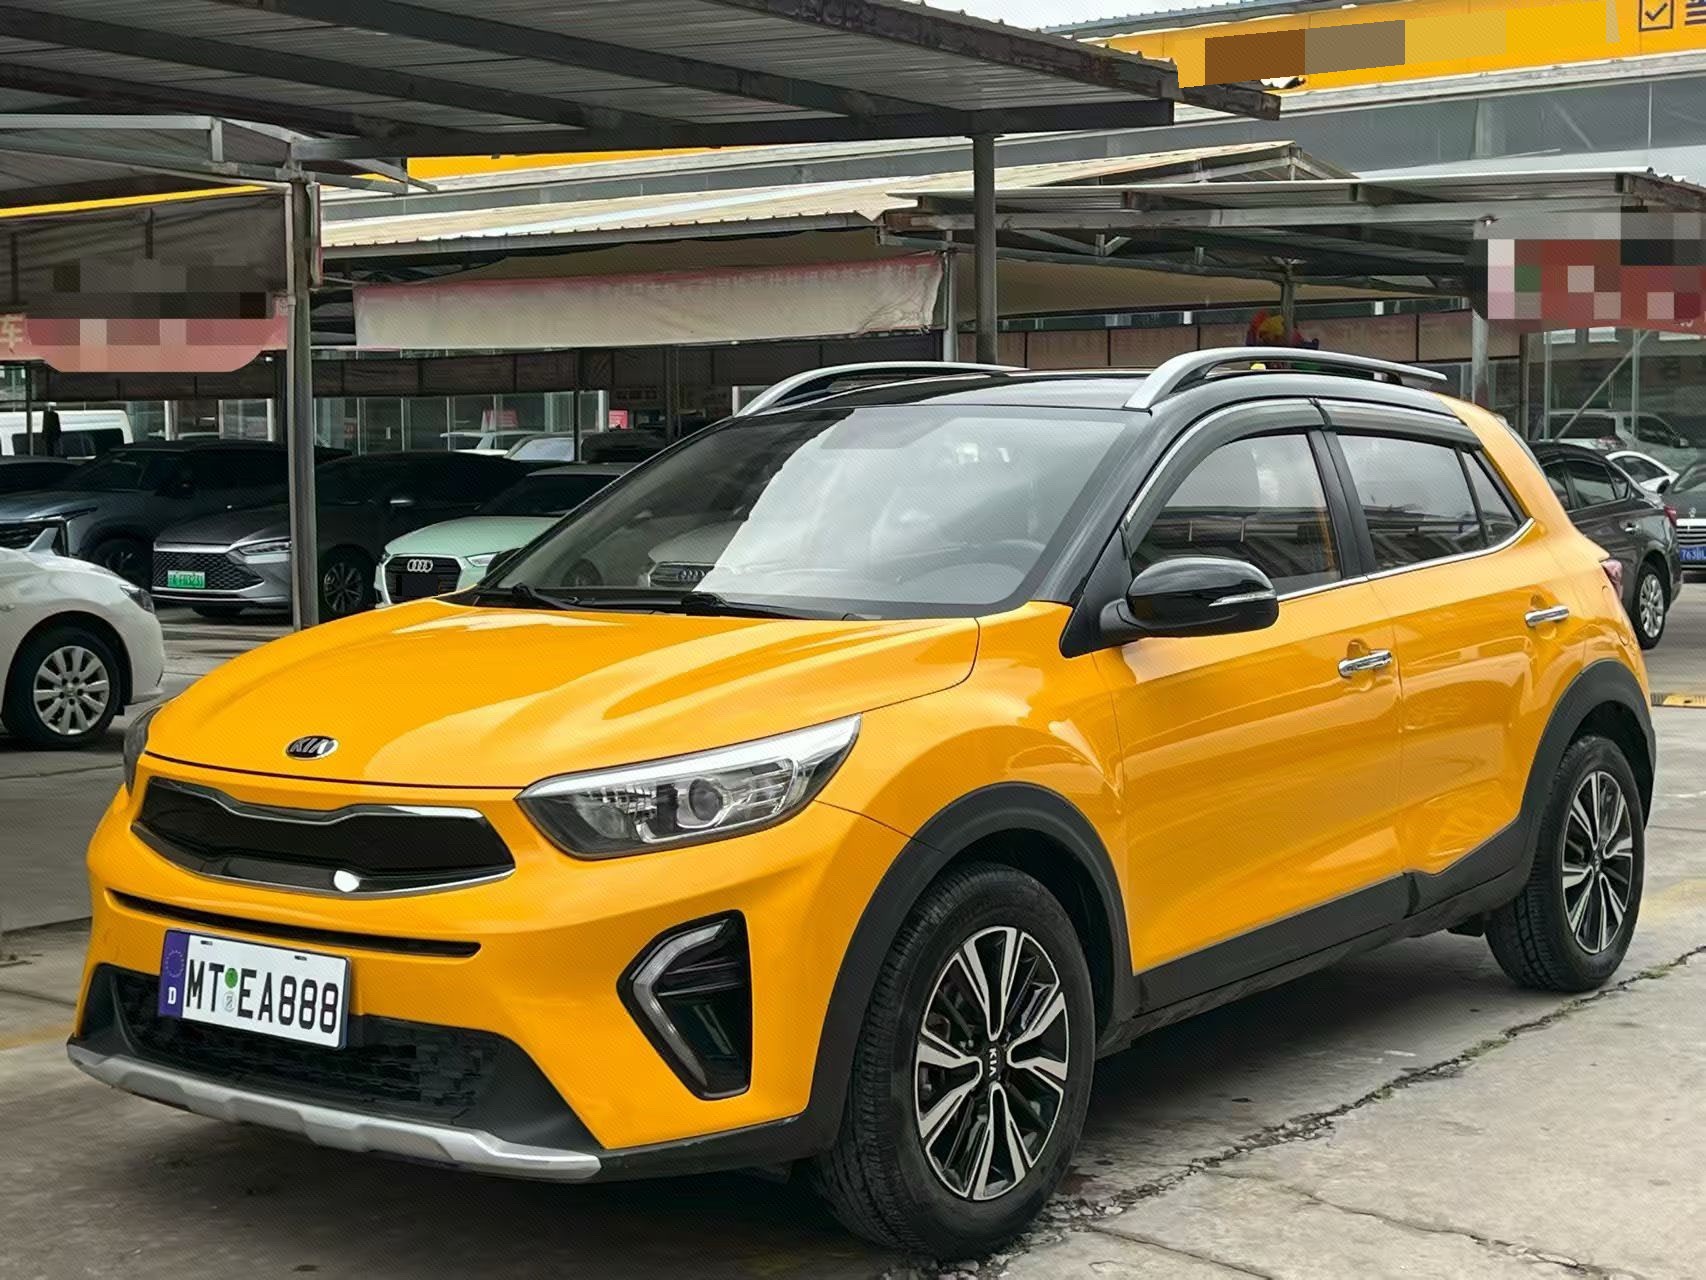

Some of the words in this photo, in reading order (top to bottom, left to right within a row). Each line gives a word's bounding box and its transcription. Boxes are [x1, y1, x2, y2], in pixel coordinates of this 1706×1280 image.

[288, 736, 336, 757] KIA
[167, 986, 177, 1005] D
[186, 959, 225, 1012] MT
[237, 968, 338, 1034] EA888
[988, 1047, 997, 1077] KIA
